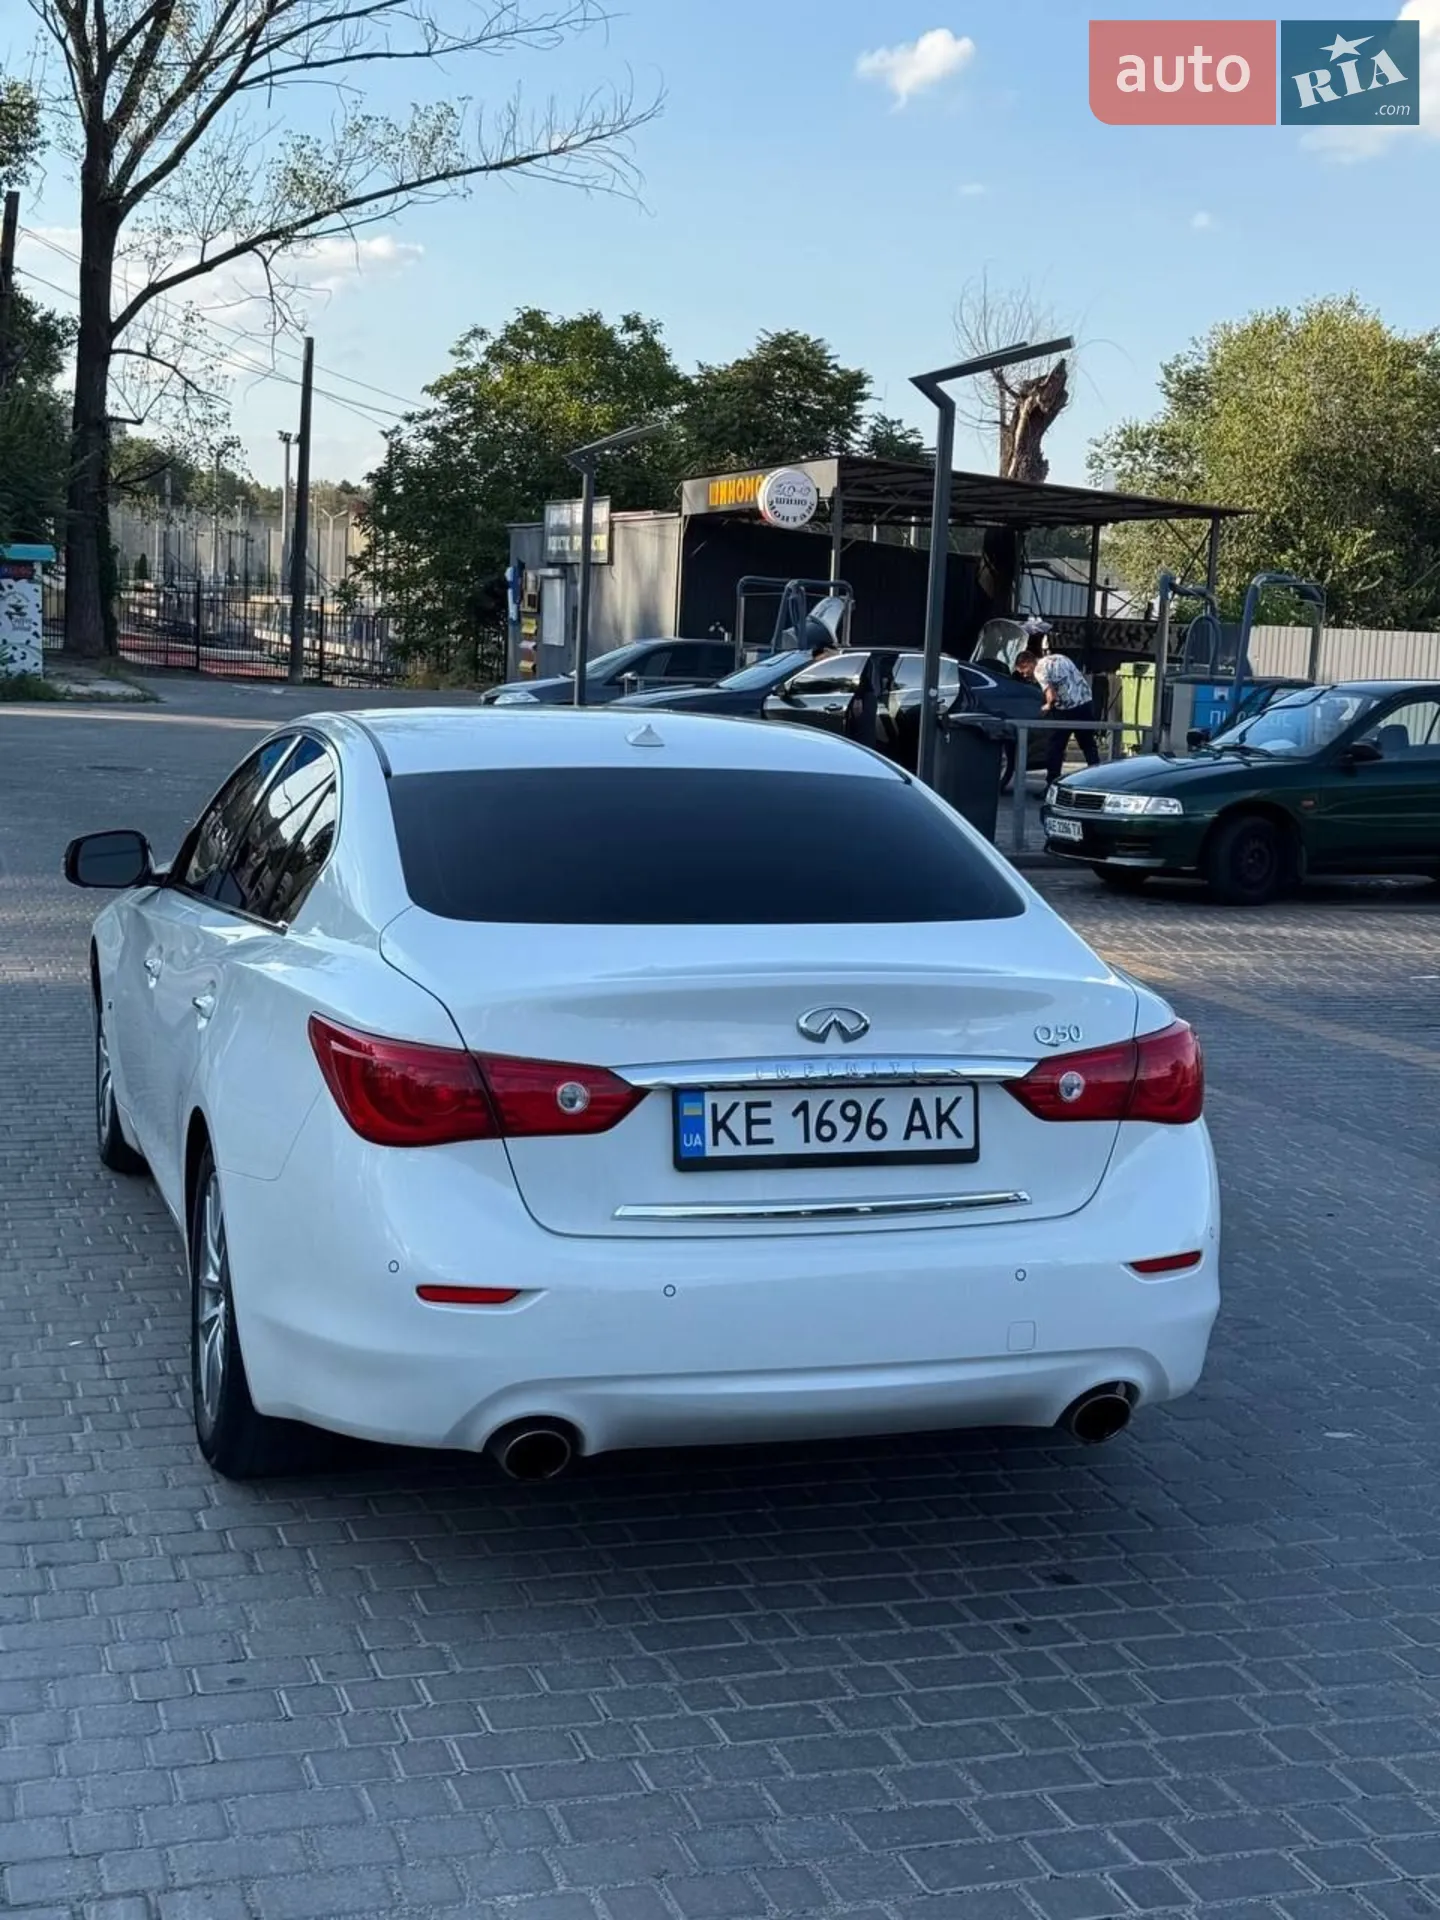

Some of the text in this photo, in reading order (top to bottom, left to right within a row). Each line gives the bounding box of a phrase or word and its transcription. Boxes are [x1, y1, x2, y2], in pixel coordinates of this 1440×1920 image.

[1034, 1024, 1082, 1047] Q50
[711, 1096, 964, 1146] KE 1696 AK
[683, 1133, 703, 1147] UA
